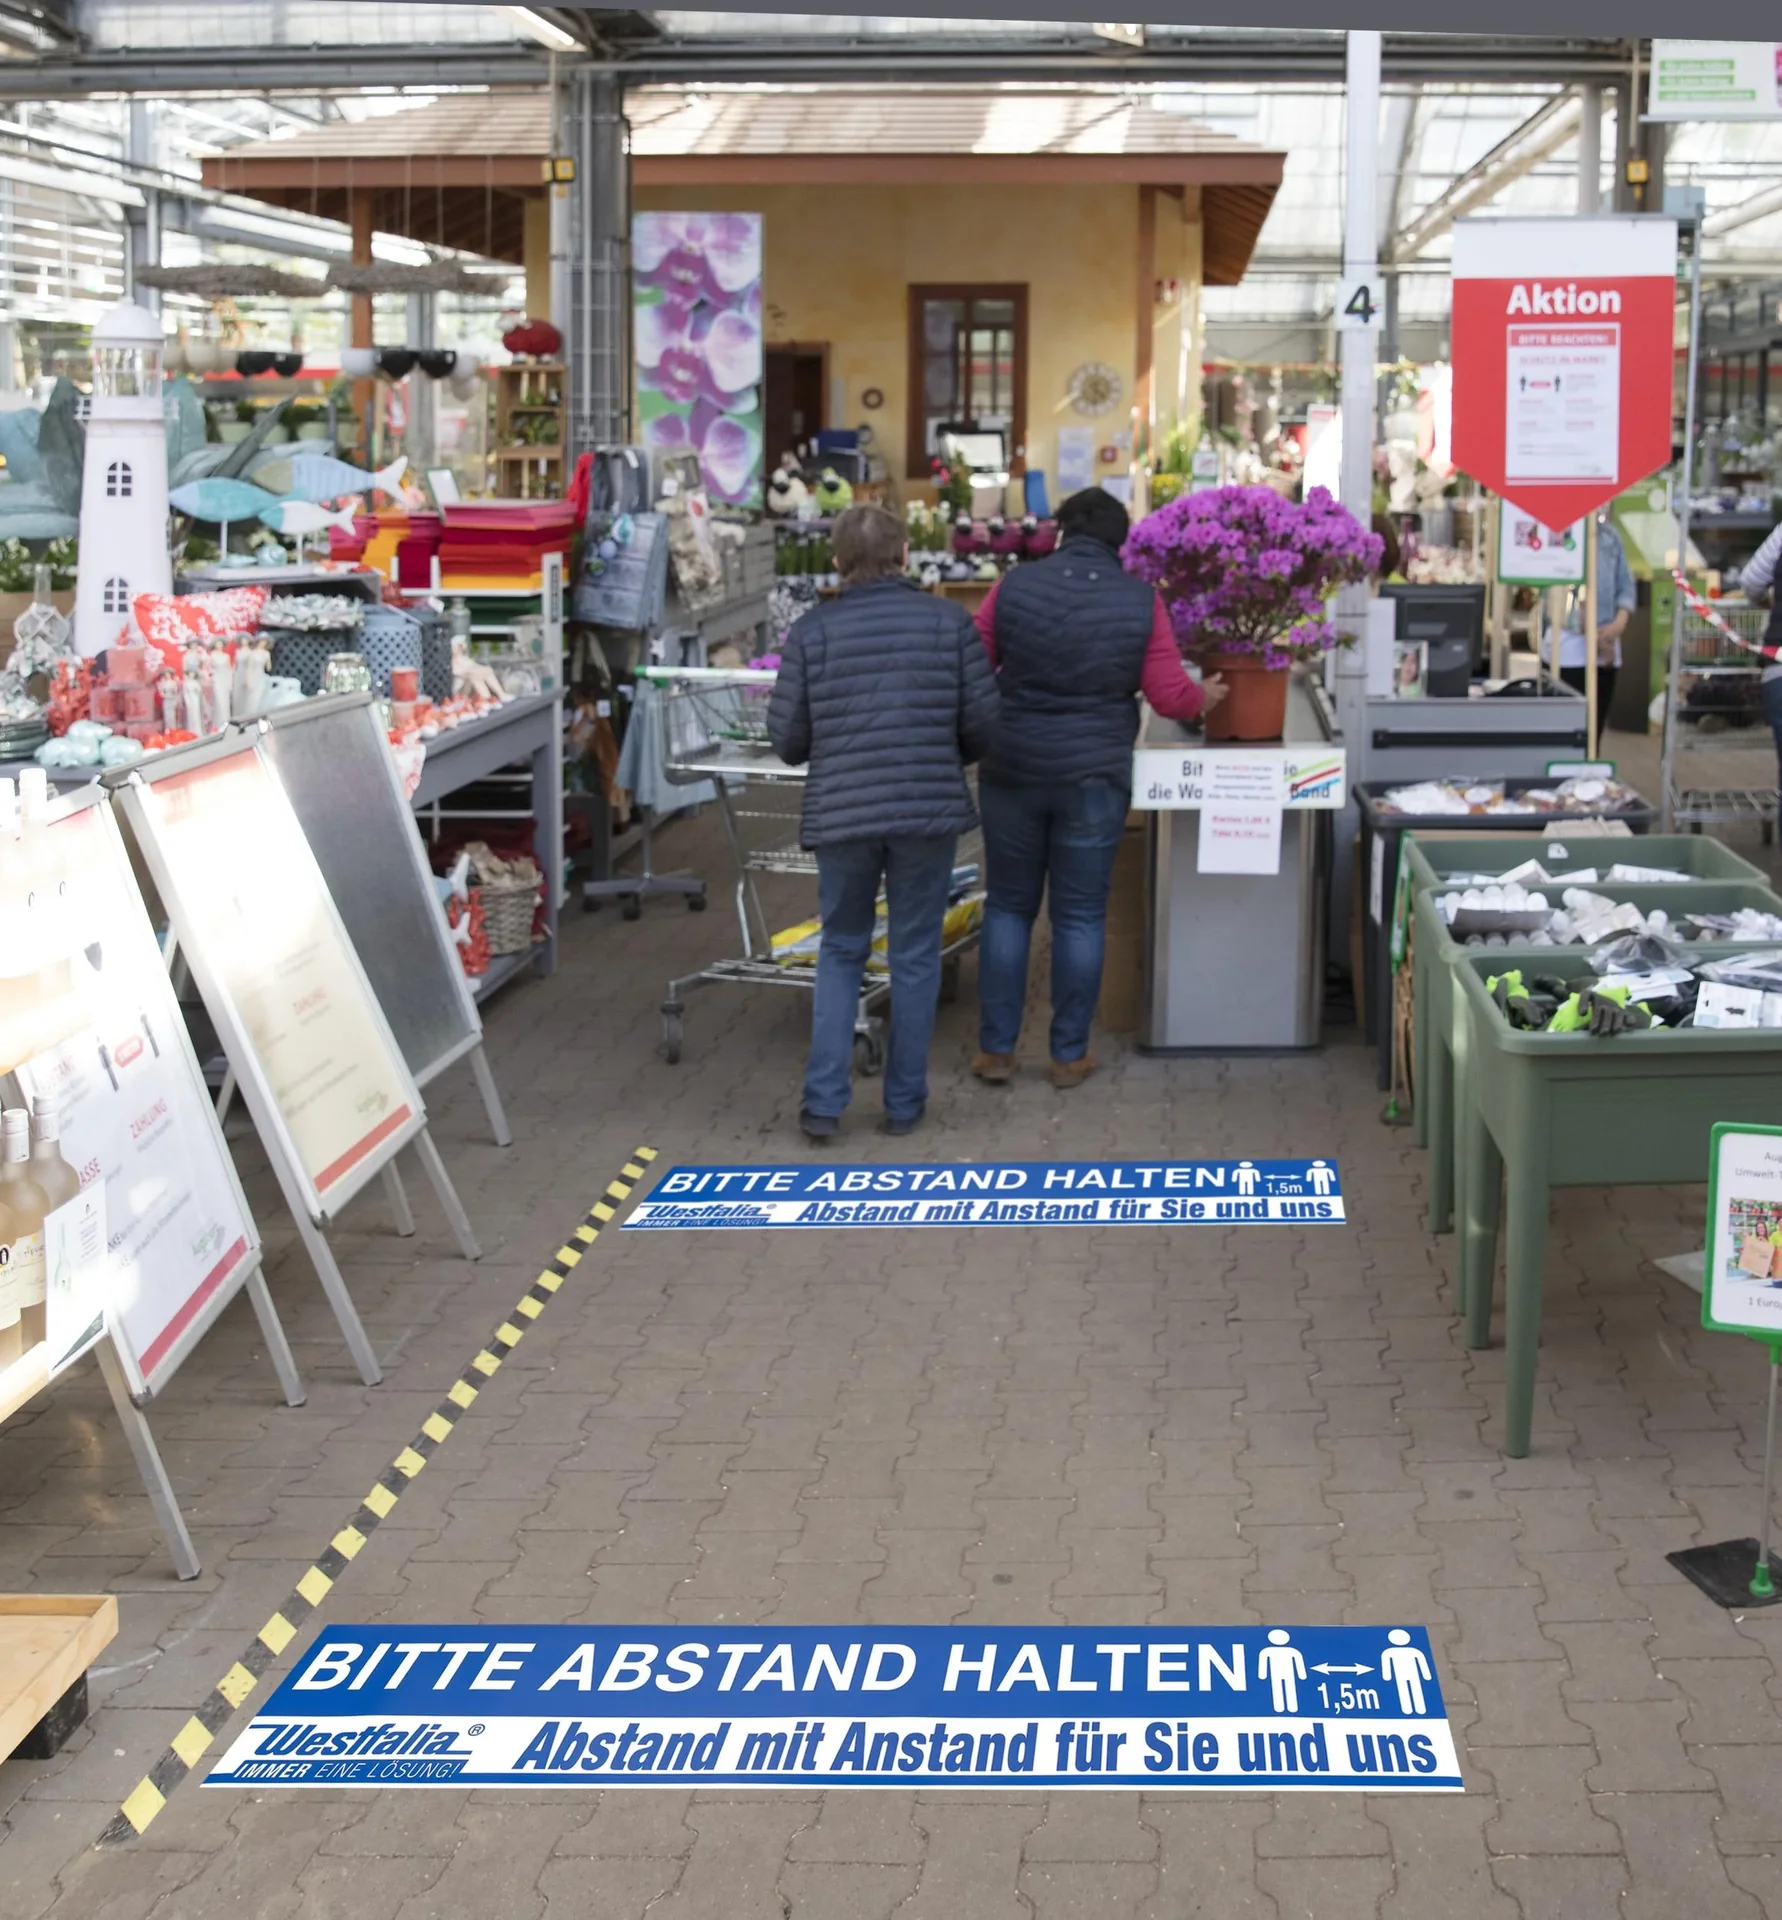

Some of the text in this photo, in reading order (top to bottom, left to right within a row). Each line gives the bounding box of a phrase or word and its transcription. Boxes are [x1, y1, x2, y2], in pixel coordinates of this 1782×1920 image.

[1344, 285, 1375, 323] 4
[1506, 283, 1621, 315] Aktion
[1182, 760, 1203, 777] Bit
[1283, 760, 1299, 776] ie
[1147, 782, 1172, 800] die
[1178, 783, 1203, 800] Wa
[1289, 784, 1331, 800] Band
[80, 1157, 101, 1186] ASSE
[660, 1167, 1225, 1193] BITTE ABSTAND HALTEN
[1266, 1182, 1303, 1194] 1,5m
[636, 1218, 682, 1227] IMMER
[640, 1203, 772, 1218] Westfalia
[795, 1198, 1333, 1222] Abstand mit Anstand für Sie und uns
[291, 1643, 1248, 1692] BITTE ABSTAND HALTEN
[1316, 1682, 1380, 1712] 1,5m
[250, 1723, 474, 1756] Westfalia
[511, 1721, 1438, 1774] Abstand mit Anstand für Sie und uns
[233, 1760, 462, 1778] IMMER EINE LÖSUNG!
